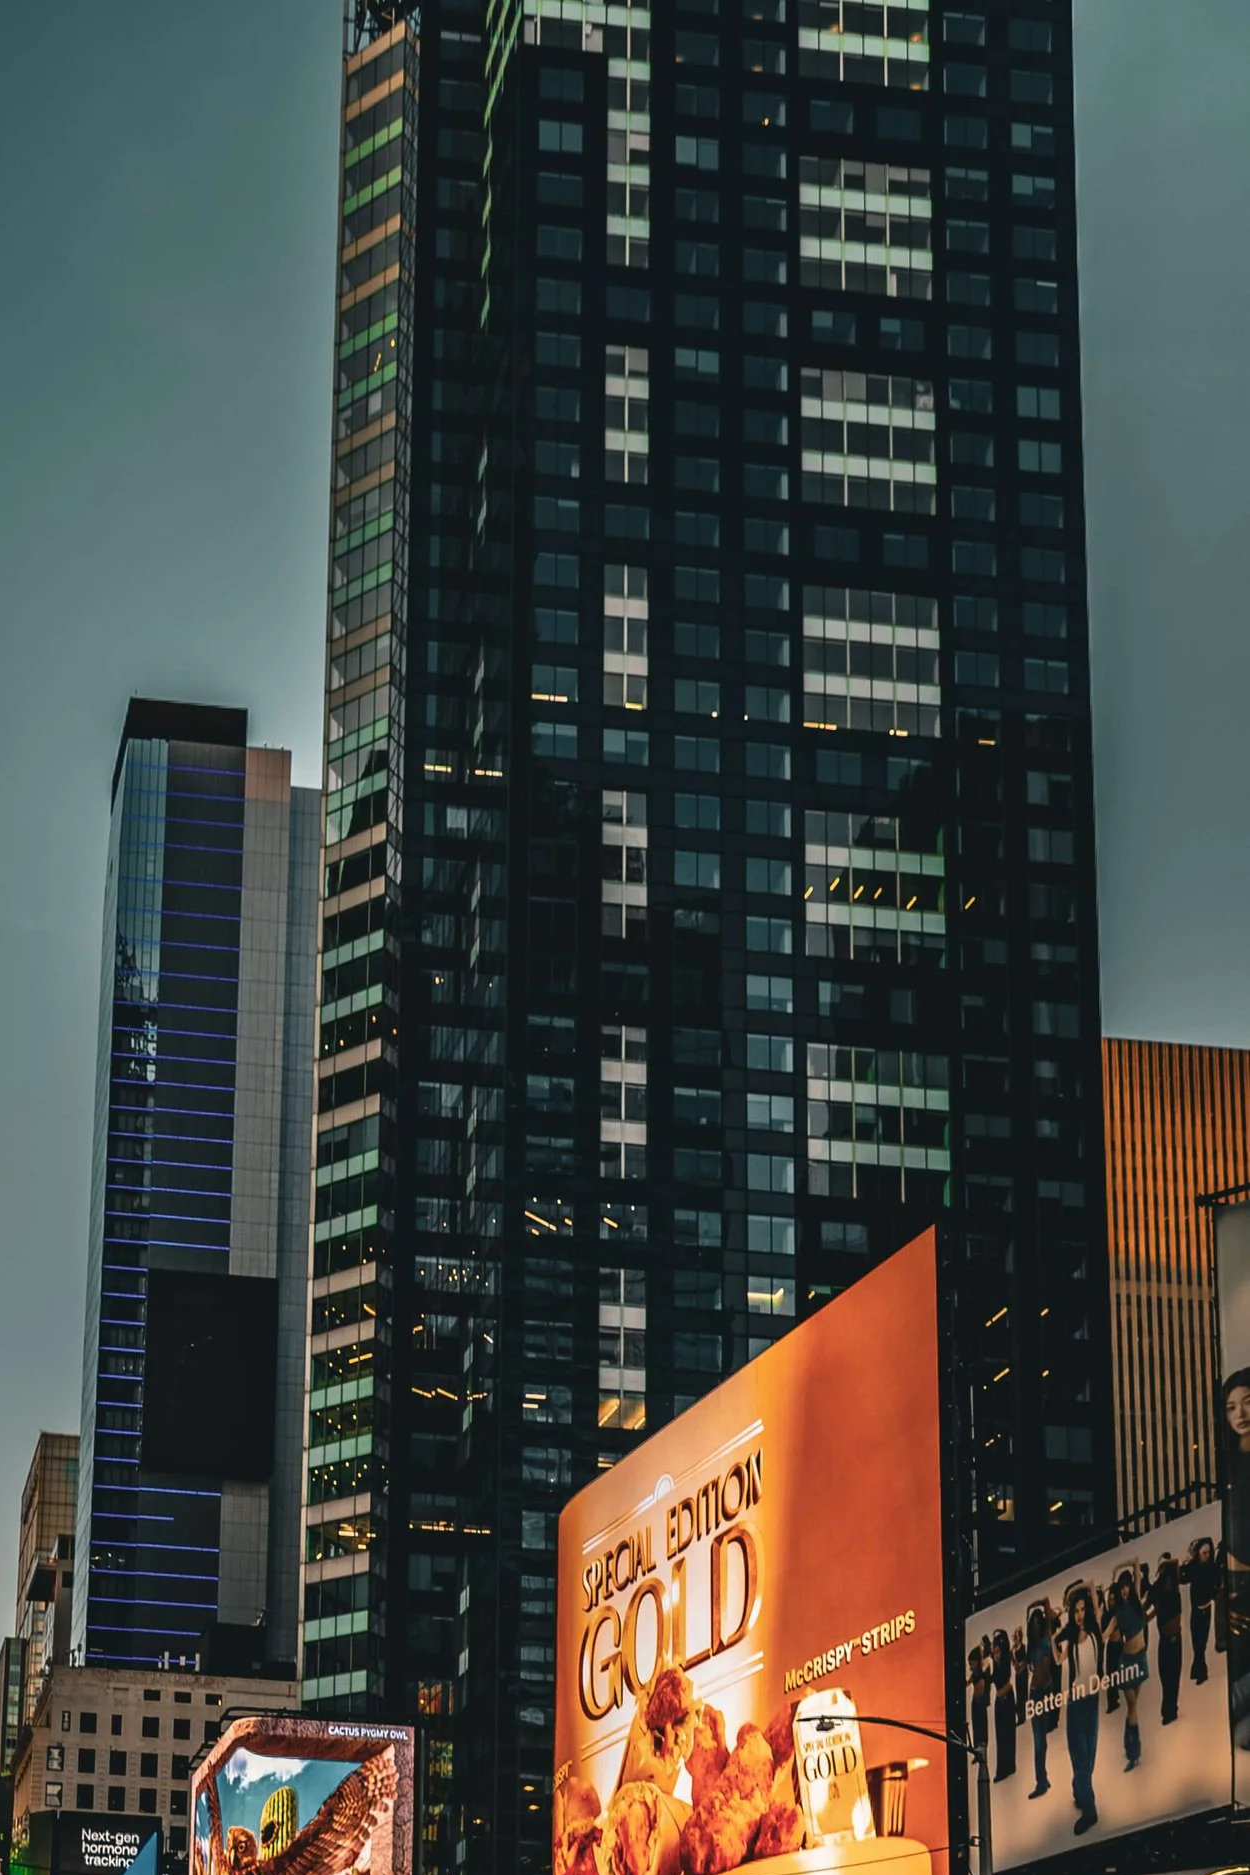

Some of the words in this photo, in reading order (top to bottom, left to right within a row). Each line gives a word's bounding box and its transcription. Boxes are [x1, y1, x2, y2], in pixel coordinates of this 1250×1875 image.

[581, 1520, 657, 1613] SPECIAL
[666, 1447, 763, 1561] EDITION
[578, 1520, 765, 1722] GOLD
[860, 1609, 916, 1656] STRIPS
[1025, 1691, 1070, 1720] Better
[1071, 1683, 1085, 1701] in
[1088, 1663, 1145, 1695] Denim.
[328, 1725, 360, 1737] CACTUS
[360, 1728, 389, 1739] PYGMY
[389, 1730, 409, 1740] OWL
[803, 1744, 858, 1784] GOLD
[81, 1827, 140, 1846] Next-gen
[81, 1841, 138, 1856] hormone
